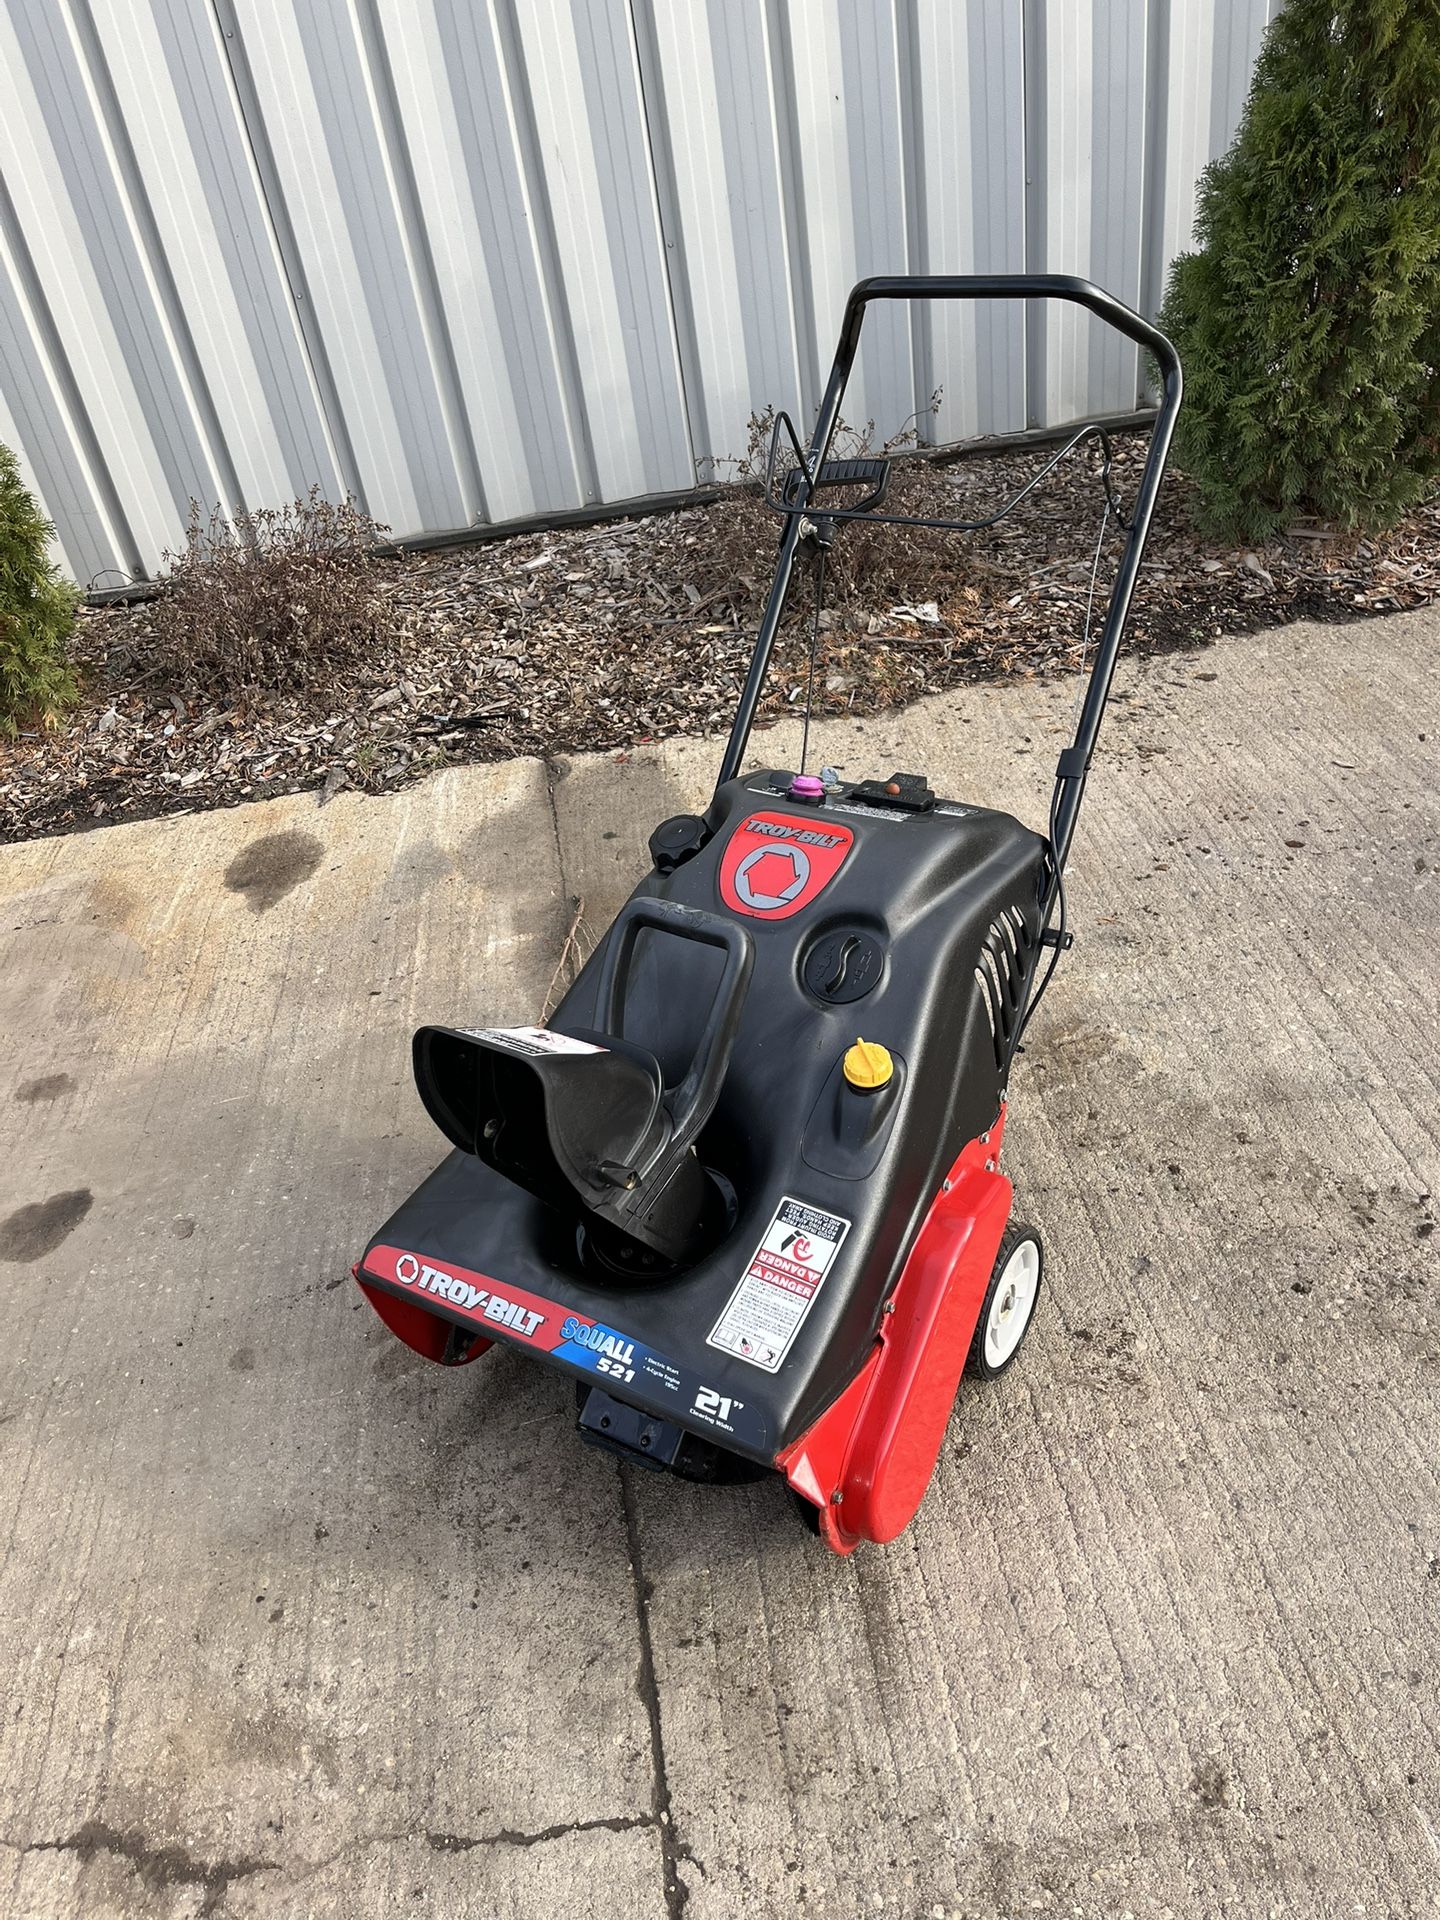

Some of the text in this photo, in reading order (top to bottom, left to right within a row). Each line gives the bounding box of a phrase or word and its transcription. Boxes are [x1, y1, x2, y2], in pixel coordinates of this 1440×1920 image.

[745, 820, 844, 849] TROY-BILT
[781, 1216, 835, 1240] AVOID INJURY FROM
[808, 1222, 837, 1236] ROTATING
[758, 1251, 807, 1277] DANGER
[763, 1271, 813, 1298] DANGER
[418, 1264, 545, 1336] TROY-BILT
[560, 1316, 635, 1365] SQUALL
[596, 1357, 636, 1383] 521
[646, 1366, 681, 1386] 4-Cycle Engine
[648, 1357, 680, 1375] Electric Start
[689, 1408, 734, 1432] Clearing Width
